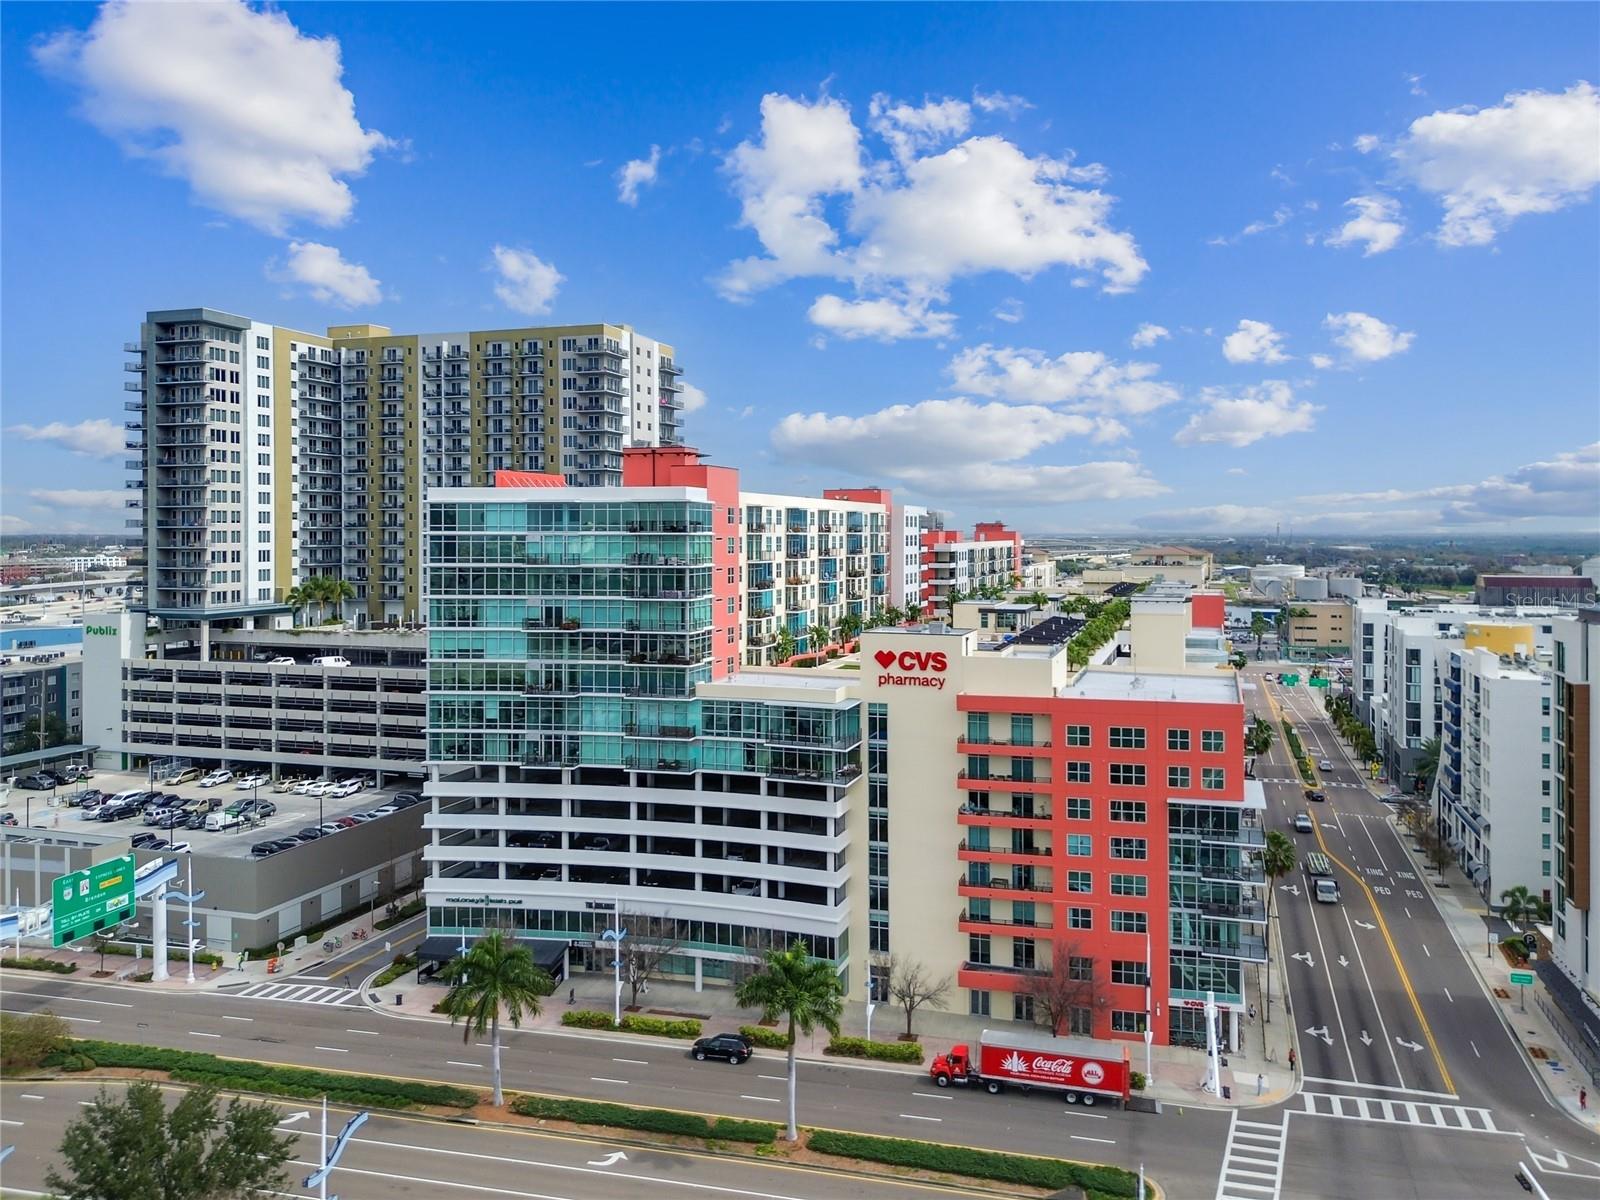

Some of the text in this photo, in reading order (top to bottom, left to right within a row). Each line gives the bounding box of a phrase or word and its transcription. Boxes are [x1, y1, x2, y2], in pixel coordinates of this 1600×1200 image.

[86, 625, 118, 636] Publix
[898, 651, 947, 672] CVS
[878, 672, 946, 690] pharmacy
[1365, 867, 1385, 876] XING
[1395, 871, 1416, 880] XING
[1373, 886, 1392, 895] PED
[1405, 889, 1424, 899] PED
[1032, 1056, 1075, 1074] Coca-Cola
